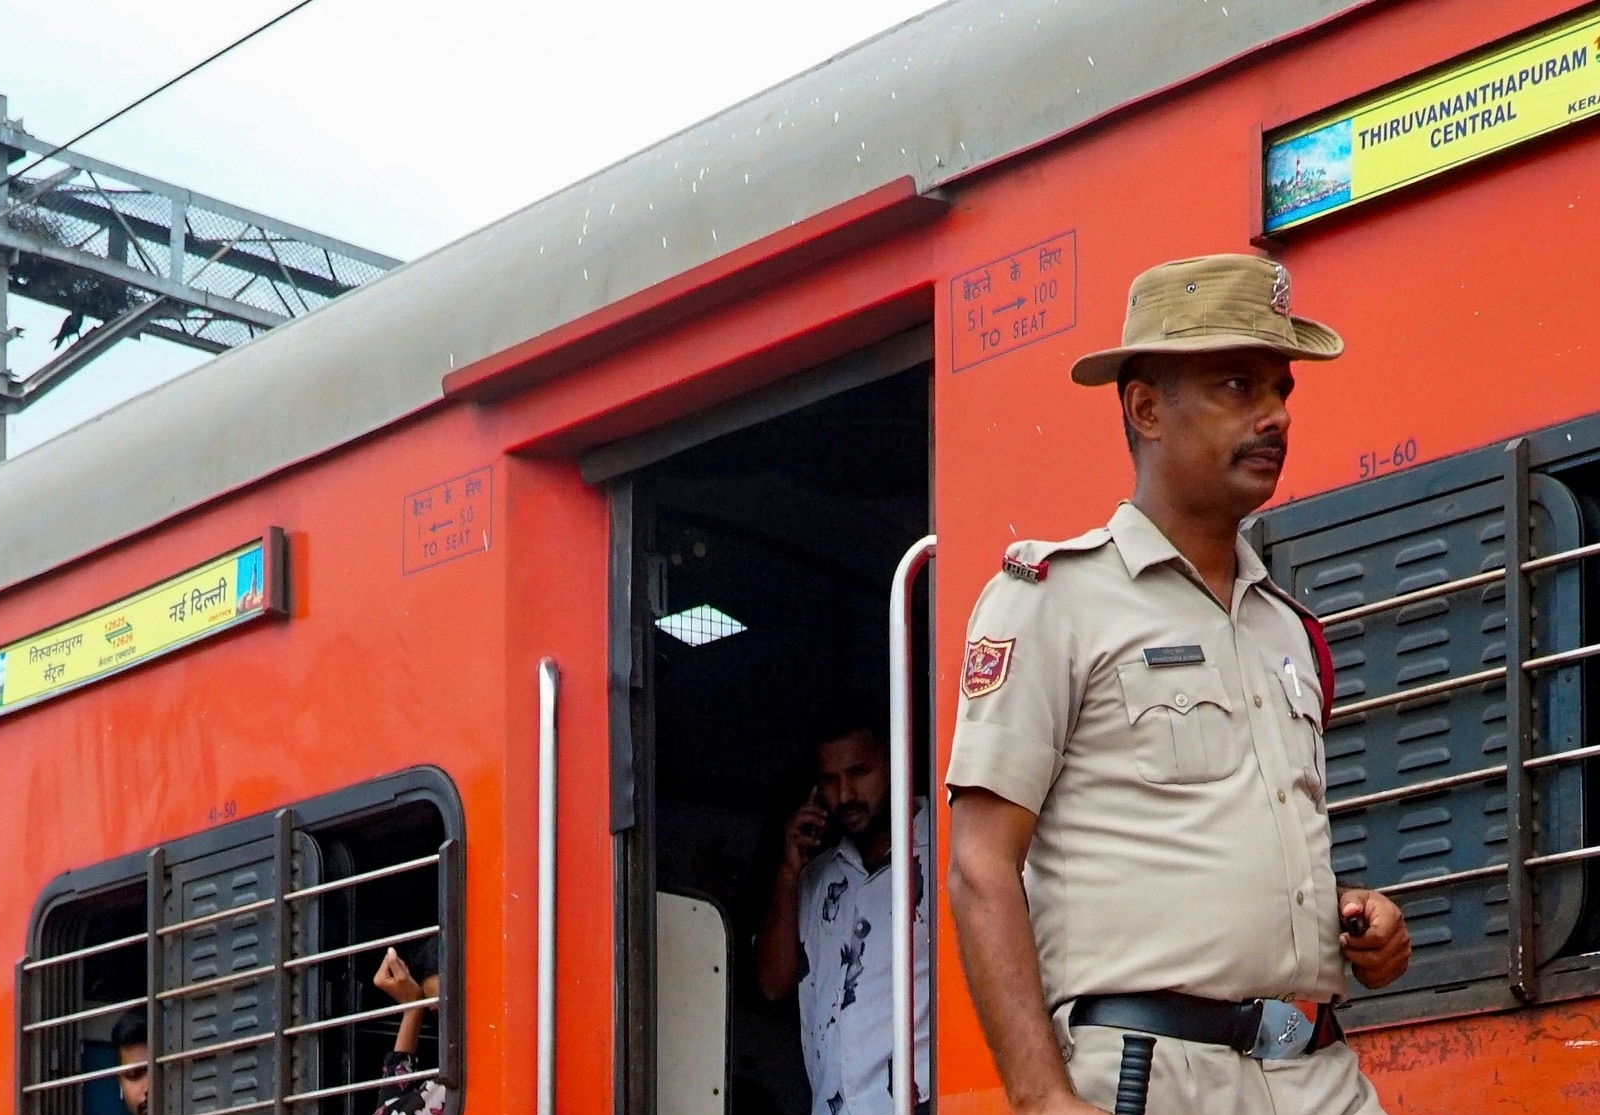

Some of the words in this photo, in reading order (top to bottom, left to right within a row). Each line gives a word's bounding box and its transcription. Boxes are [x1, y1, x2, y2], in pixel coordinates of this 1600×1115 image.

[1358, 46, 1588, 150] THIRUVANANTHAPURAM
[1568, 94, 1600, 115] KER
[1430, 101, 1517, 149] CENTRAL
[967, 306, 985, 332] 51
[1033, 279, 1058, 305] 100
[980, 329, 1001, 351] TO
[1013, 310, 1048, 339] SEAT
[1359, 438, 1417, 479] 51-60
[445, 529, 471, 552] SEAT
